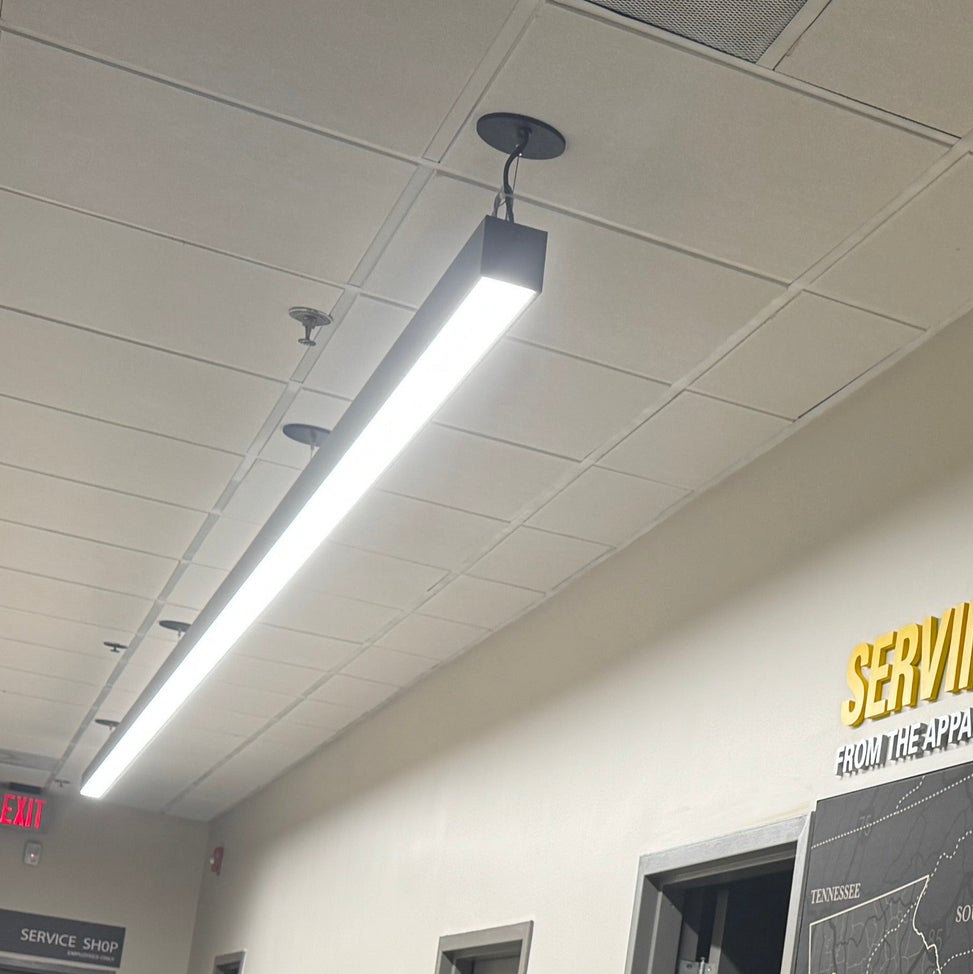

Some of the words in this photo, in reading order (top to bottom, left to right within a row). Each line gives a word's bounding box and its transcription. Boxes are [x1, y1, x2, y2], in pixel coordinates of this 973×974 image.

[834, 741, 884, 776] FROM
[887, 722, 924, 761] THE
[0, 794, 47, 830] EXIT
[810, 882, 861, 905] TENNESSEE
[20, 928, 77, 948] SERVICE
[82, 937, 119, 953] SHOP
